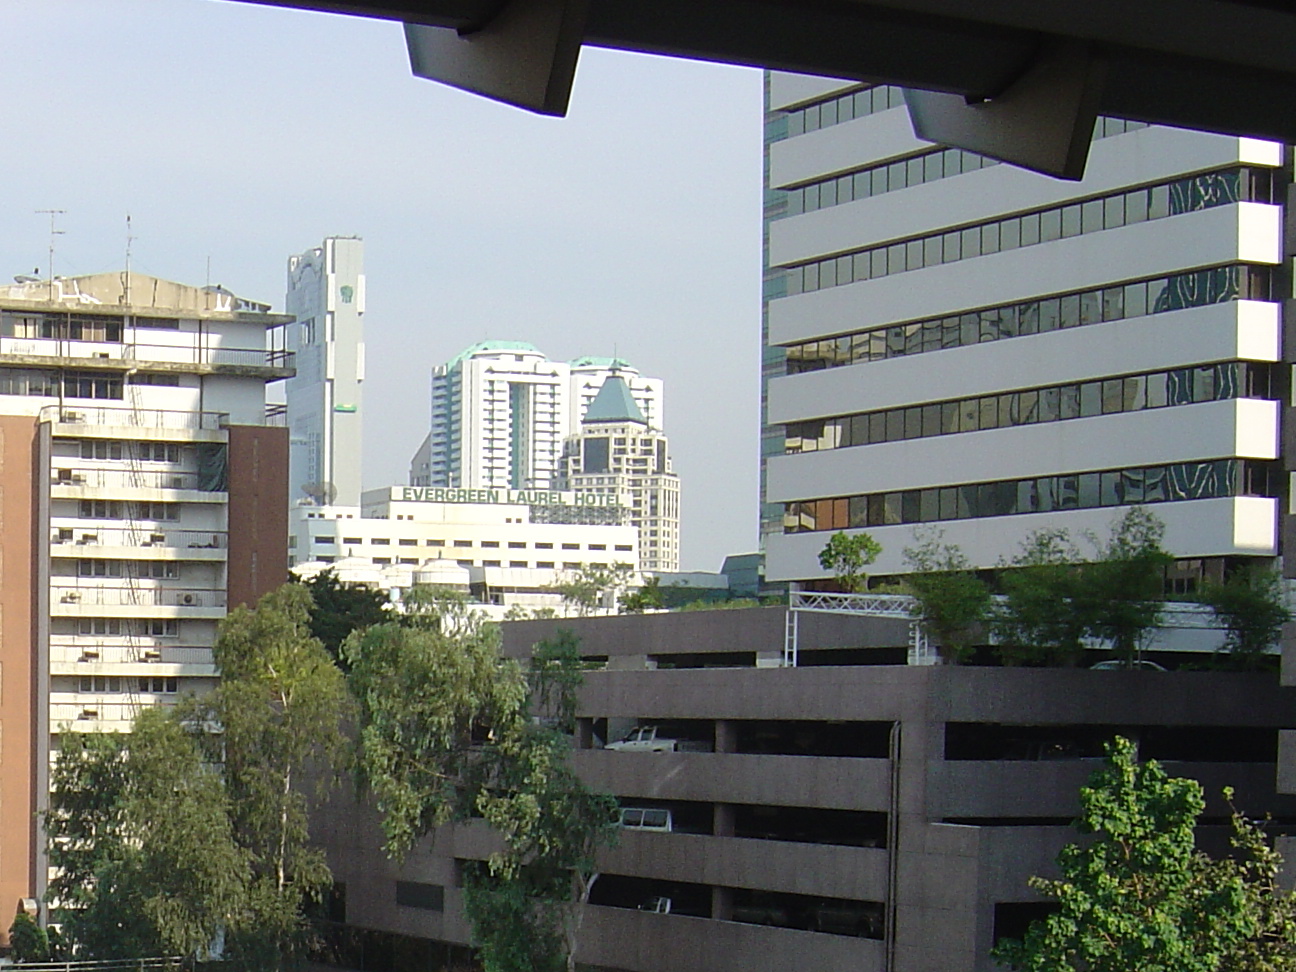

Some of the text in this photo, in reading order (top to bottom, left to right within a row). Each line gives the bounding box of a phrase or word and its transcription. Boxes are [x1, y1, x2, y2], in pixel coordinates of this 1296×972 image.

[403, 487, 623, 506] EVERGREEN LAUREL HOTEL
